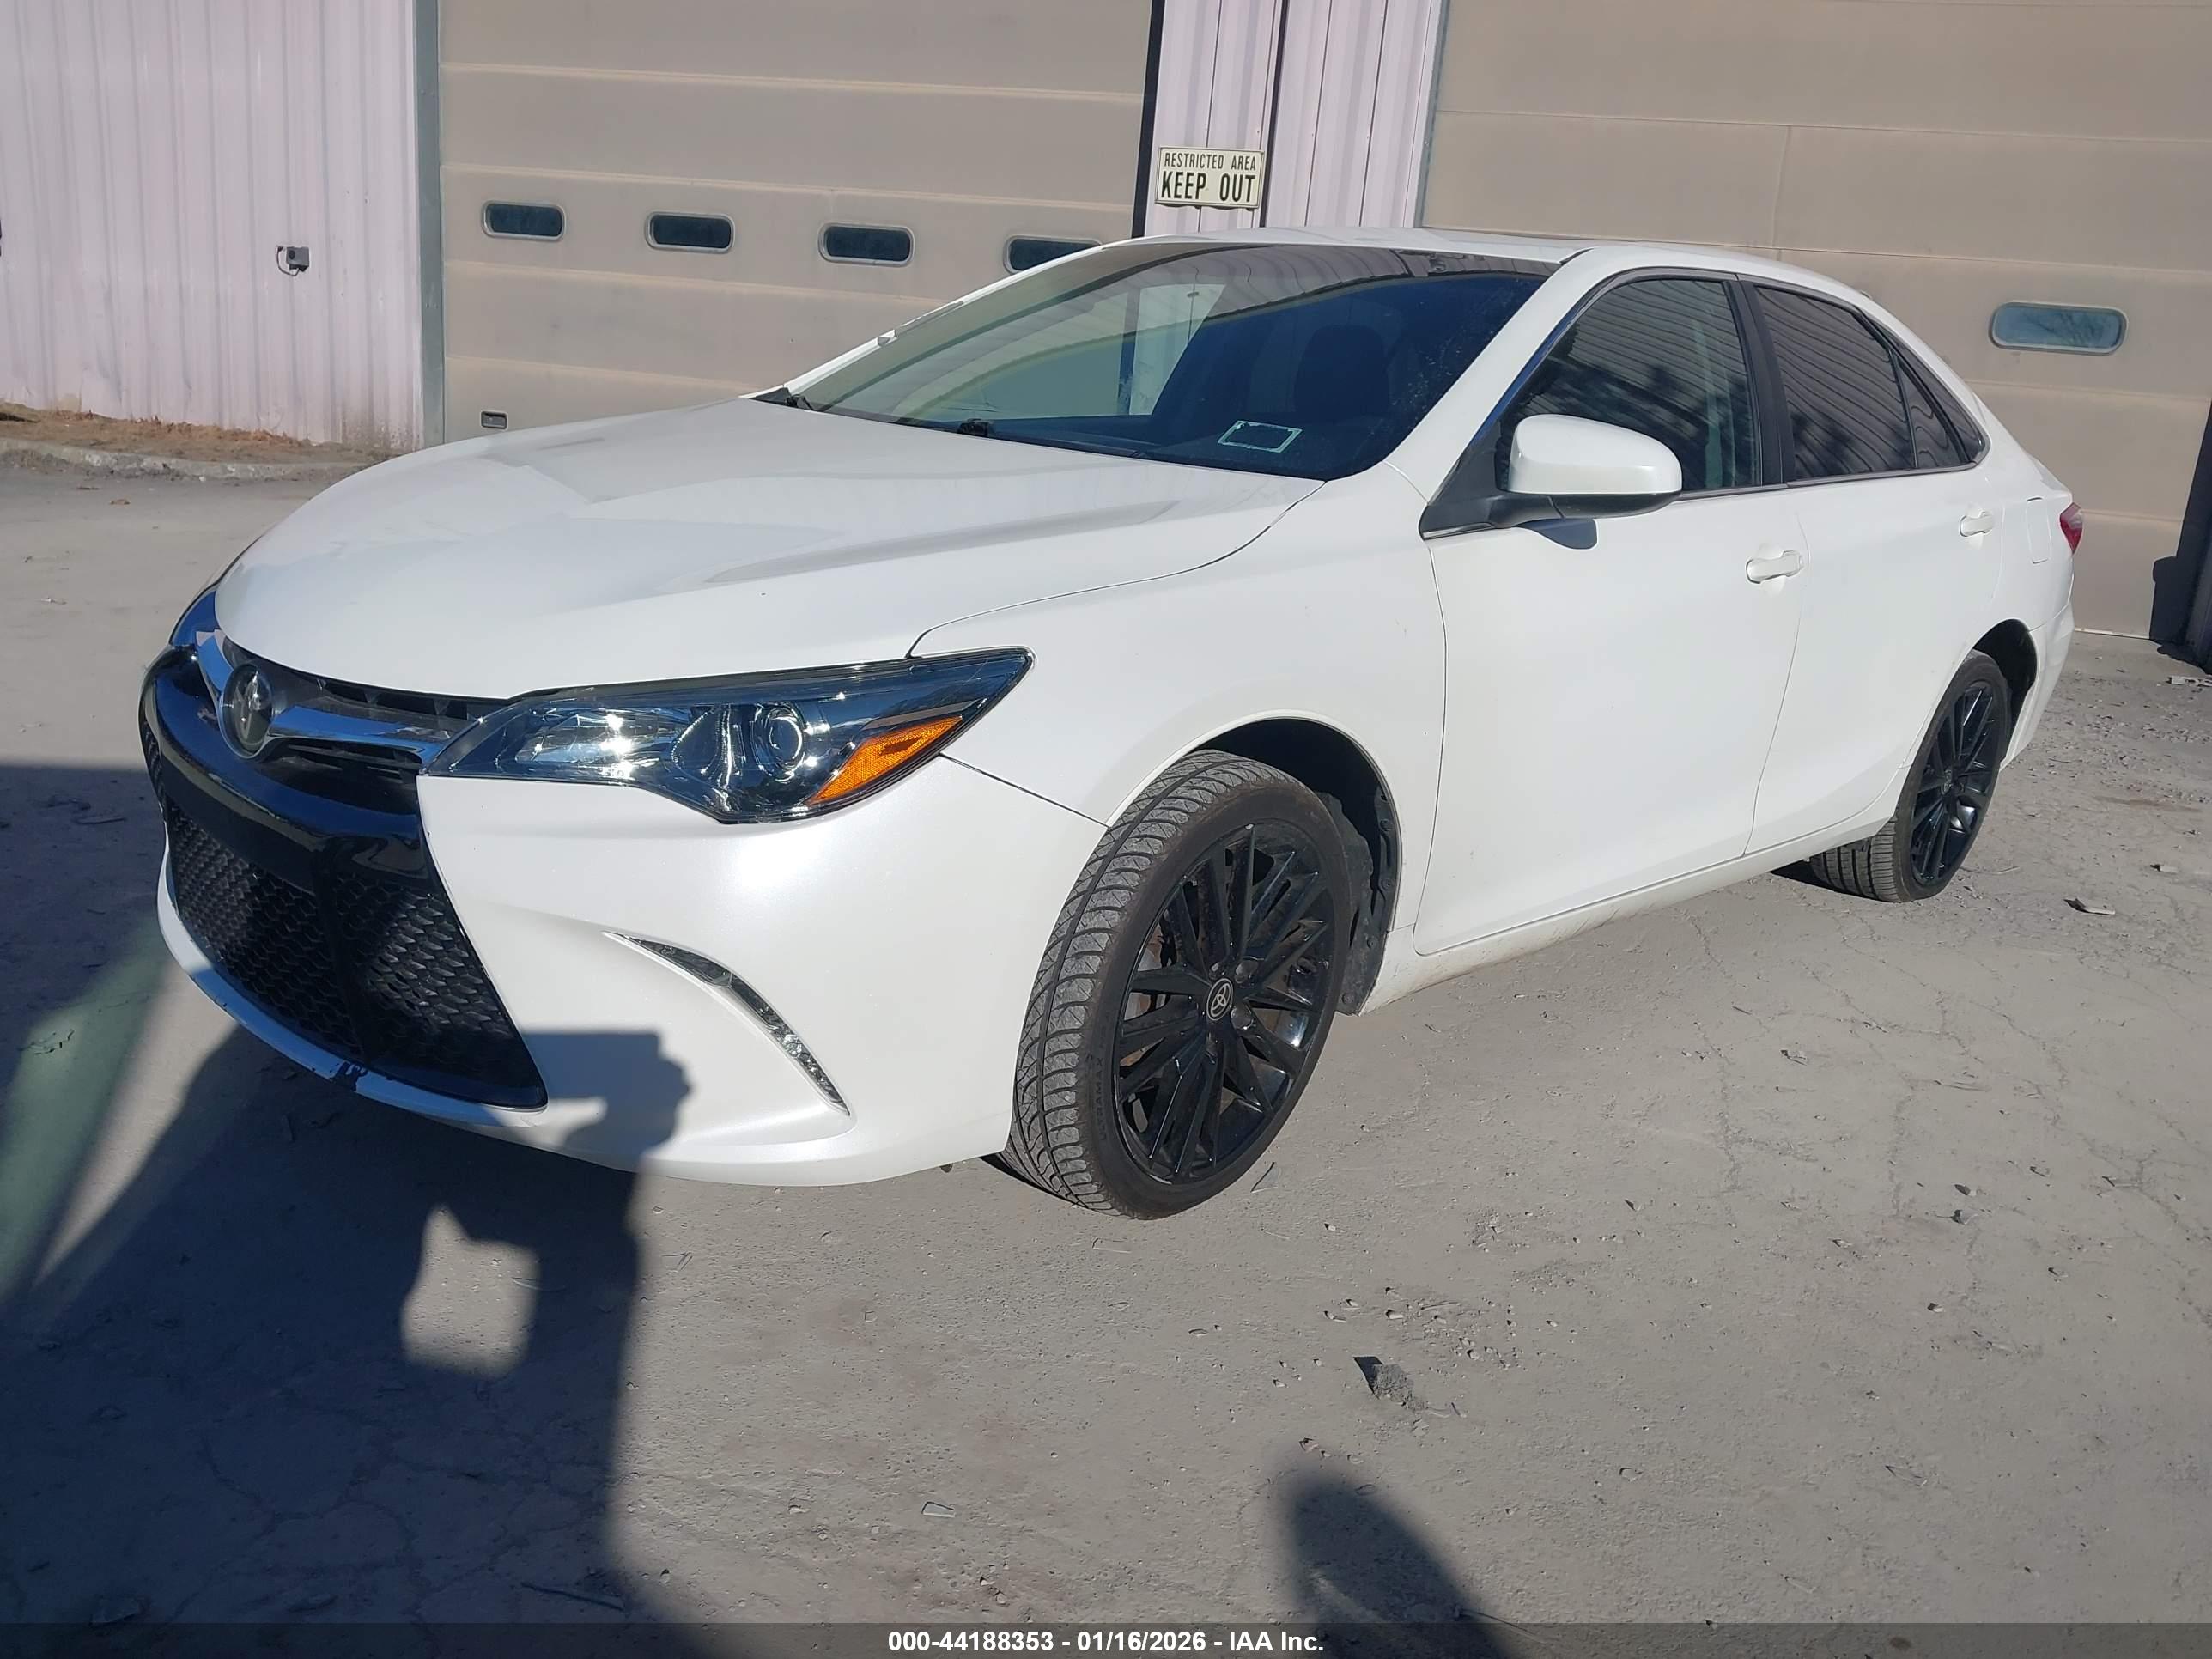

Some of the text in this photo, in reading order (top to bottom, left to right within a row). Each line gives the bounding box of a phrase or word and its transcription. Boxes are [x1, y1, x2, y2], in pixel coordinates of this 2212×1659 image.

[1164, 153, 1255, 170] RESTRICTED AREA
[1161, 171, 1255, 202] KEEP OUT
